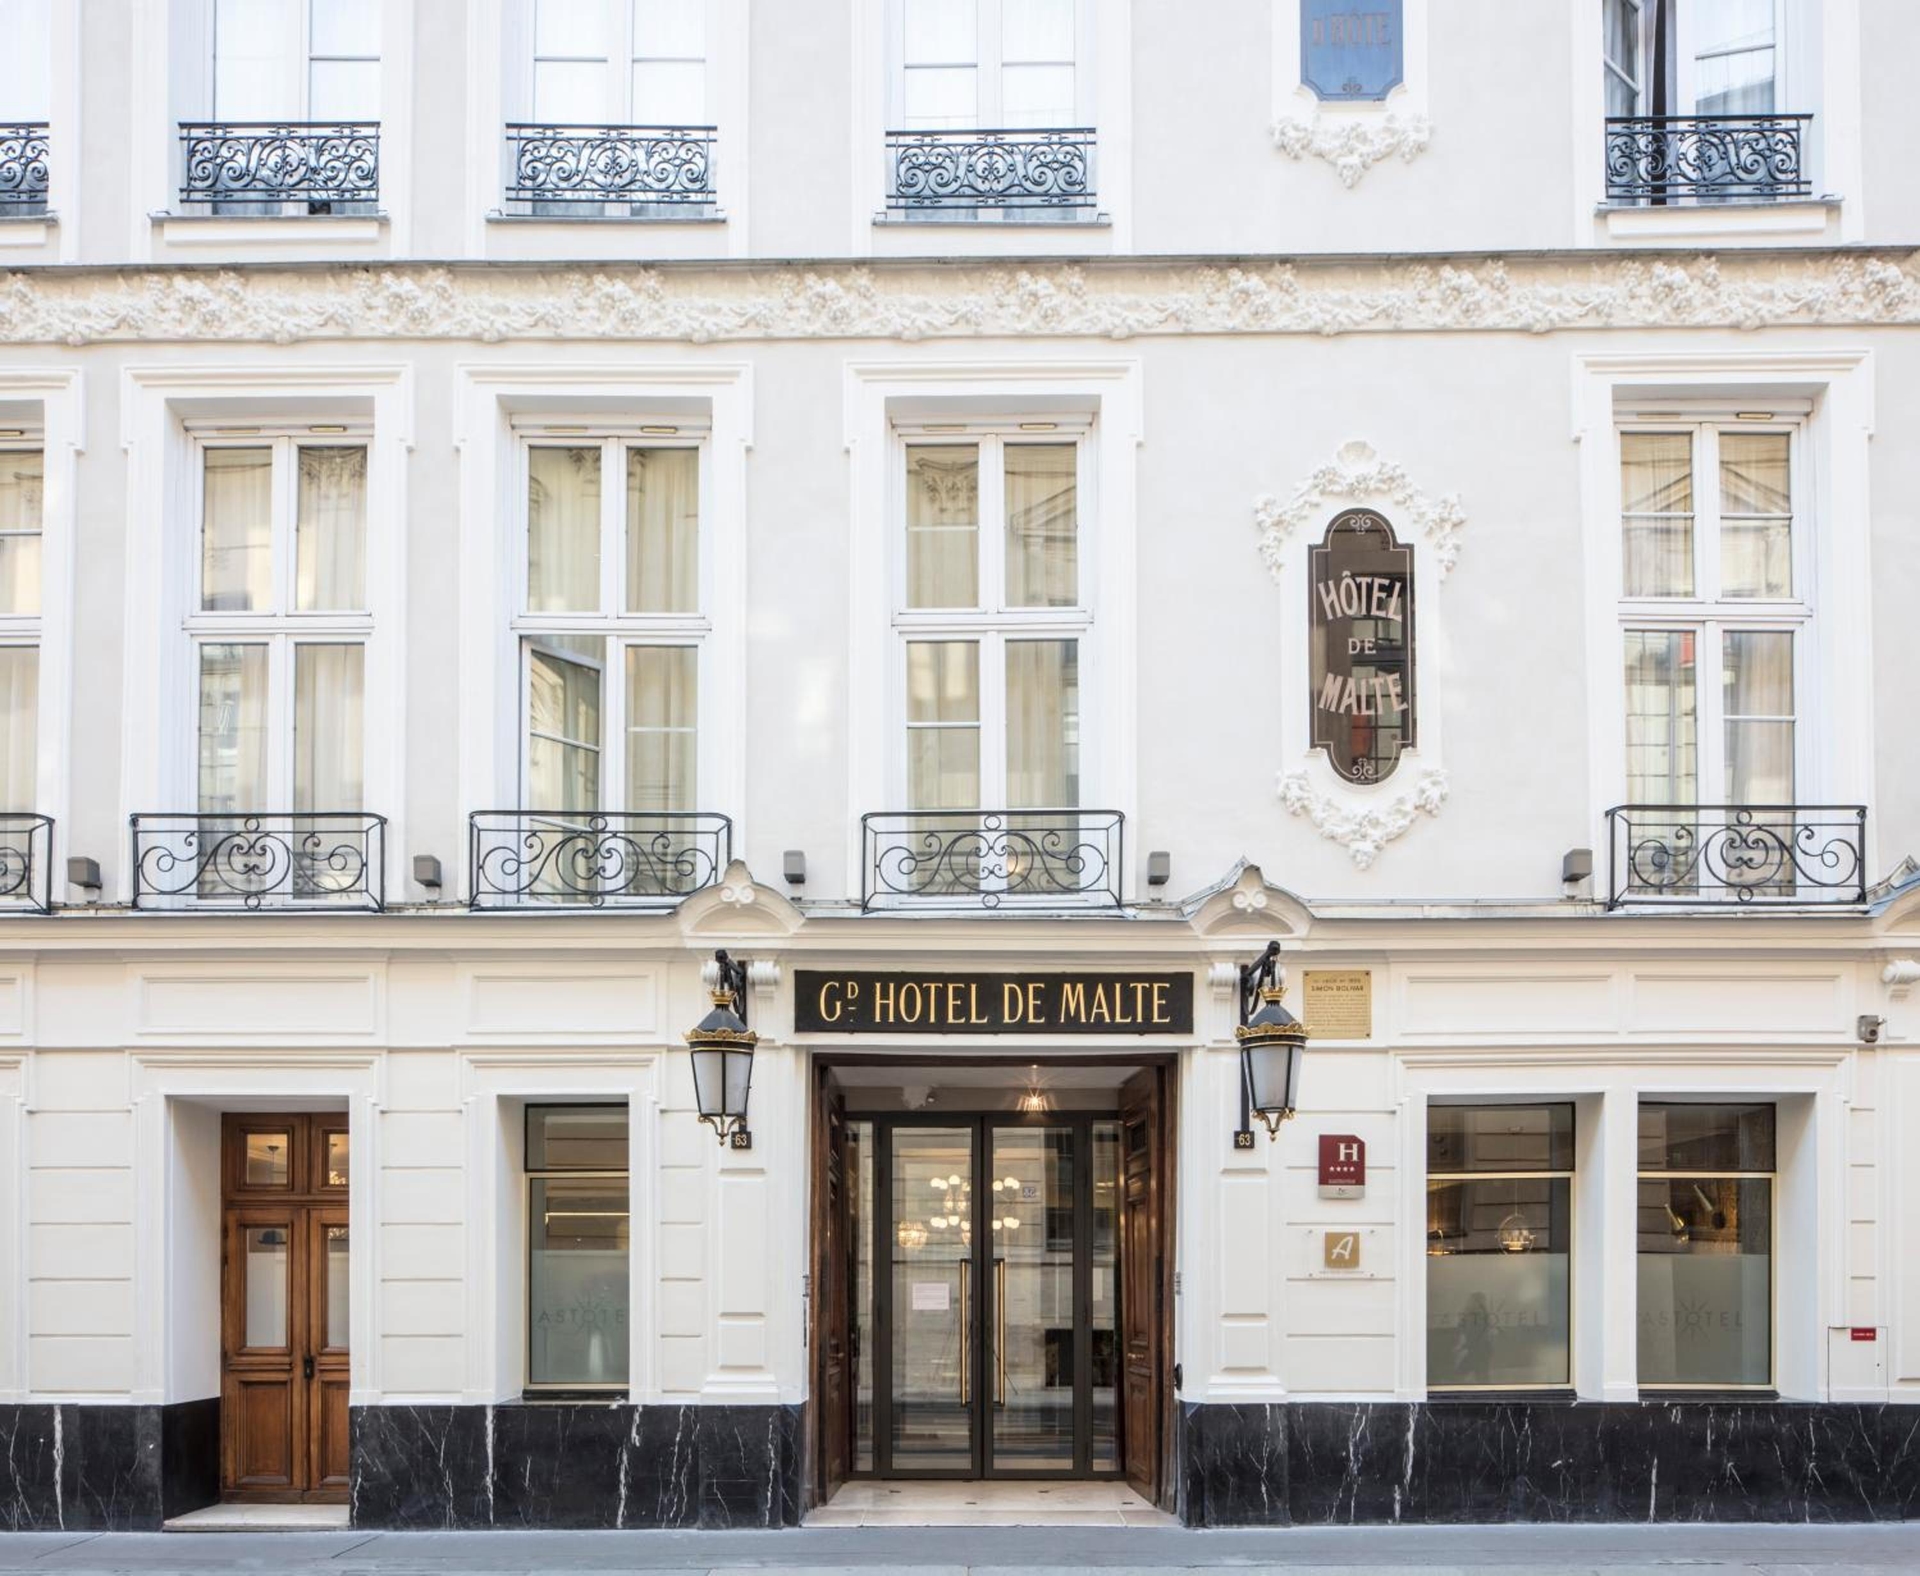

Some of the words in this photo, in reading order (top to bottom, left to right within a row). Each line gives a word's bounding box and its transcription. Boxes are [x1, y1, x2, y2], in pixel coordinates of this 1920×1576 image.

[1318, 570, 1402, 622] HÔTEL
[1348, 638, 1377, 654] DE
[1318, 672, 1408, 715] MALTE
[874, 982, 988, 1023] HOTEL
[1003, 982, 1045, 1023] DE
[1060, 982, 1170, 1023] MALTE
[735, 1134, 747, 1146] 63
[1238, 1133, 1251, 1146] 63
[1338, 1143, 1359, 1161] H
[1331, 1236, 1353, 1260] A
[1641, 1310, 1743, 1327] ASTOTEL
